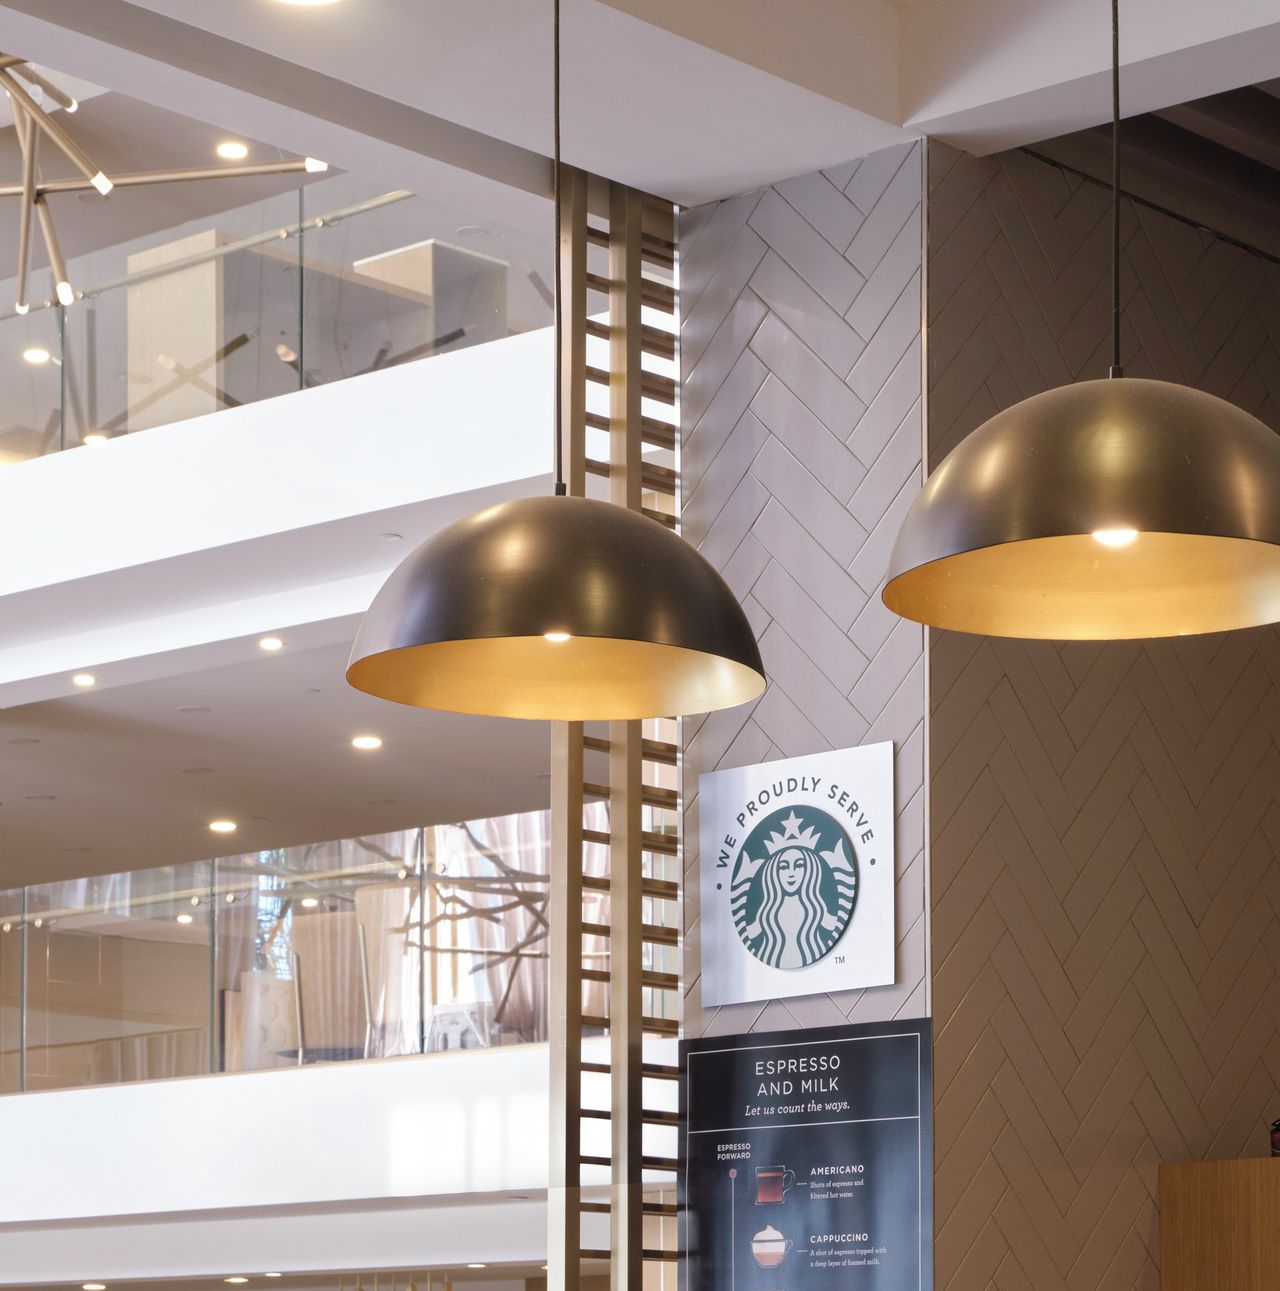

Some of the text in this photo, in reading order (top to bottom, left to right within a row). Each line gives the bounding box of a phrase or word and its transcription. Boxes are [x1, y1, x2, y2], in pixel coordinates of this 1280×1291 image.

[716, 776, 875, 868] WE PROUDLY SERVE
[755, 1055, 840, 1076] ESPRESSO
[757, 1077, 839, 1096] AND MILK
[745, 1100, 850, 1116] Let us count the ways.
[717, 1143, 751, 1151] ESPRESSO
[717, 1152, 751, 1160] FORWARD
[810, 1164, 864, 1176] AMERICANO
[810, 1233, 869, 1243] CAPPUCCINO
